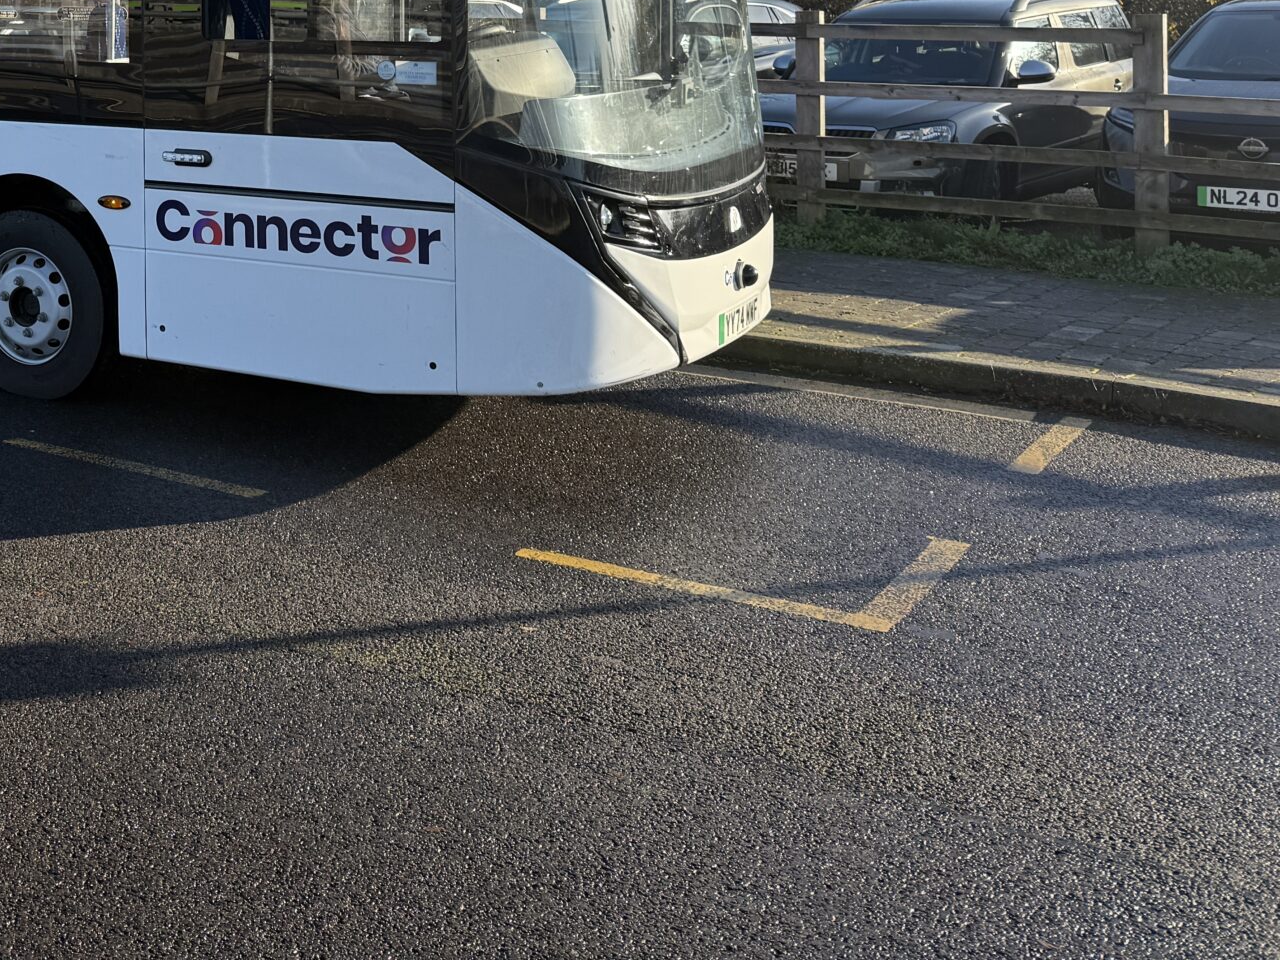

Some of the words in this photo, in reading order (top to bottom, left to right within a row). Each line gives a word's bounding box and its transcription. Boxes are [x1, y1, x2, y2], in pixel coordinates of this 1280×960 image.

[1210, 188, 1261, 207] NL24
[155, 198, 442, 266] Connector
[726, 305, 745, 337] YY74
